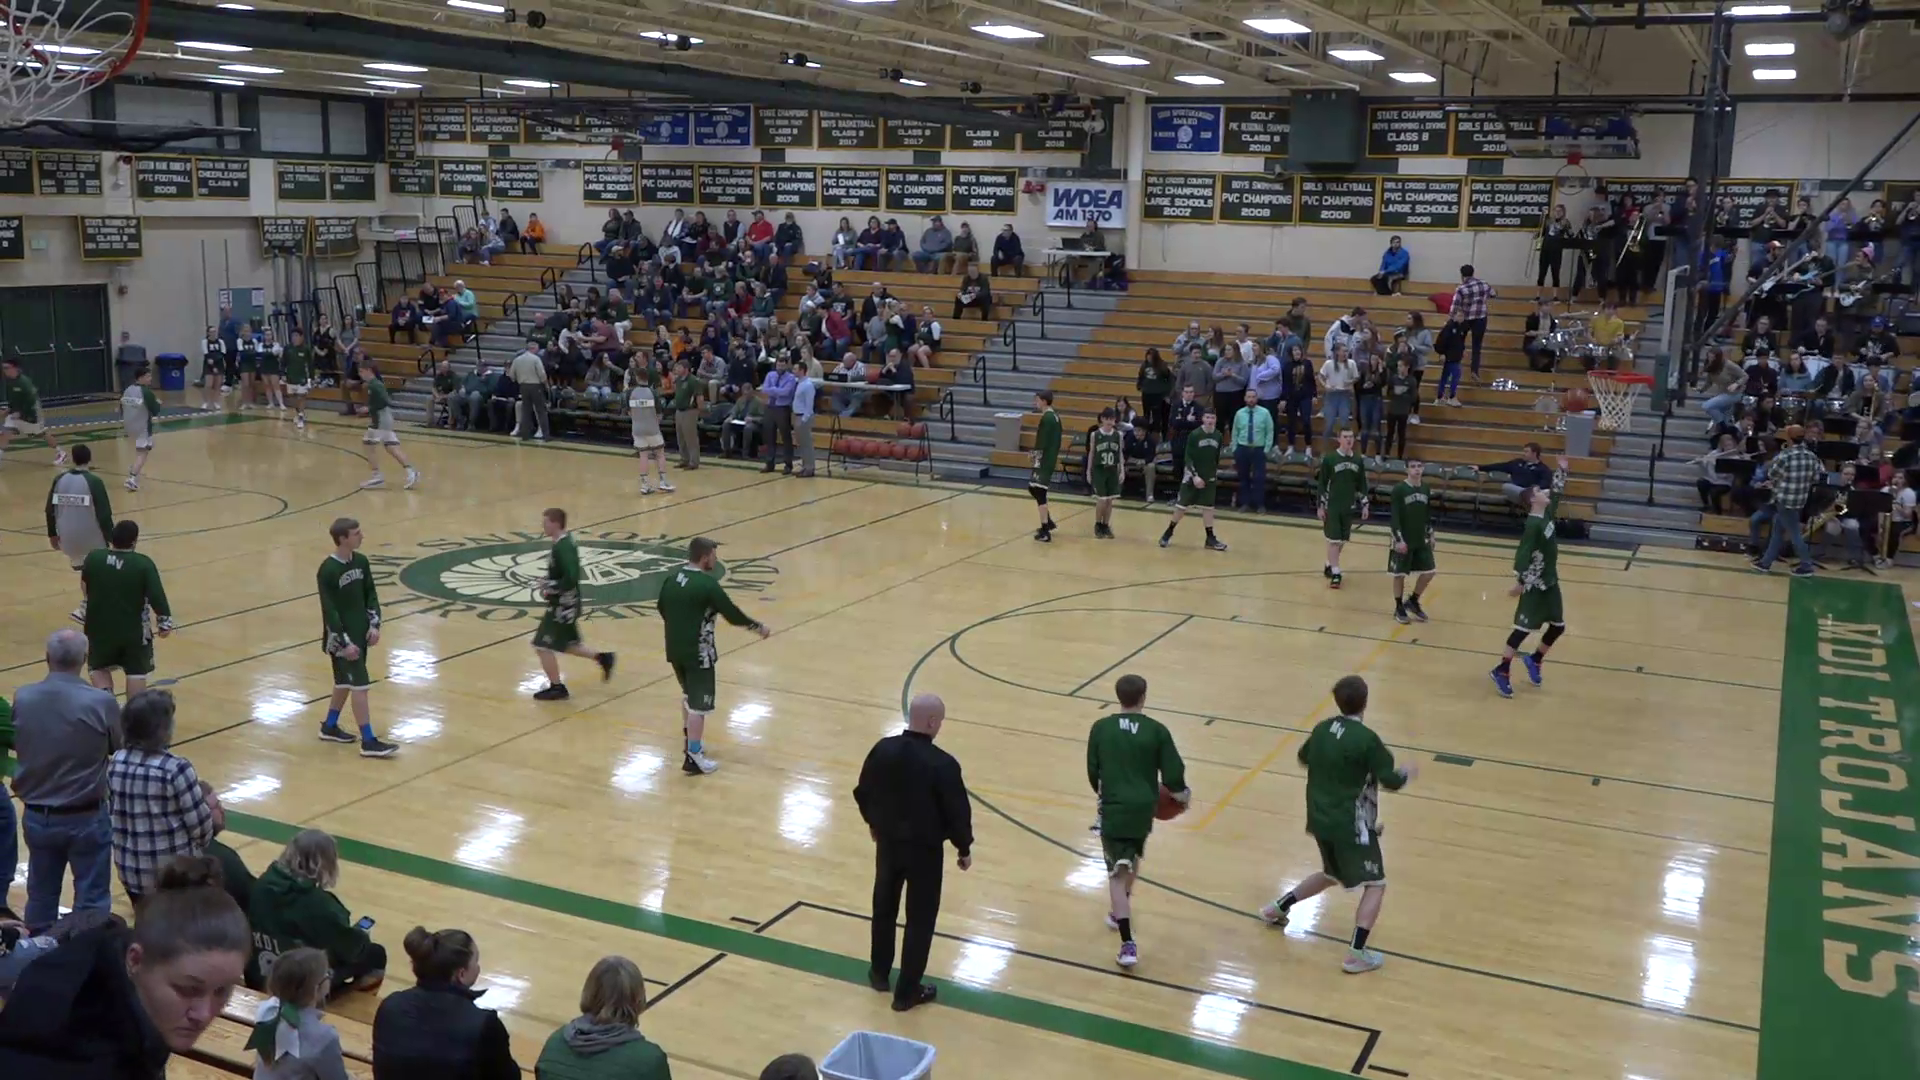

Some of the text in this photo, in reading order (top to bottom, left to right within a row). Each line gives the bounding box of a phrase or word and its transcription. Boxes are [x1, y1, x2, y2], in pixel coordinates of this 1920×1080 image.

[778, 109, 810, 118] CHAMPIONS
[1250, 110, 1276, 120] GOLF
[1377, 110, 1444, 120] STATE CHAMPIONS
[433, 115, 465, 123] CHAMPIONS
[471, 115, 518, 124] PVC CHAMPIONS
[821, 119, 876, 129] BOYS BASKETBALL
[471, 124, 520, 133] LARGE SCHOOLS
[1371, 121, 1447, 130] BOYS SWIMMING DIVING
[1458, 121, 1481, 131] GIRLS
[832, 129, 854, 137] CLASS
[1037, 130, 1063, 138] CLASS
[1241, 133, 1281, 143] CLASS B
[1387, 131, 1430, 141] CLASS B
[839, 138, 858, 146] 2017
[903, 137, 924, 145] 2017
[1176, 142, 1193, 150] GOLF
[197, 170, 248, 179] CHEERLEADING
[491, 171, 539, 180] PVC CHAMPIONS
[642, 167, 656, 177] BOYS
[761, 170, 777, 179] BOYS
[856, 170, 880, 179] COUNTRY
[154, 173, 191, 183] FOOTBALL
[440, 173, 488, 183] PVC CHAMPIONS
[583, 173, 634, 183] PVC CHAMPIONS
[699, 176, 754, 187] PVC CHAMPIONS
[888, 173, 904, 182] BOYS
[959, 174, 1008, 184] BOYS SWIMMING
[1146, 175, 1215, 186] GIRLS CROSS COUNTRY
[208, 179, 231, 187] CLASS
[491, 180, 539, 189] LARGE SCHOOLS
[583, 182, 635, 191] LARGE SCHOOLS
[641, 178, 694, 190] PVC CHAMPIONS
[760, 181, 817, 193] PVC CHAMPIONS
[823, 177, 879, 189] PVC CHAMPIONS
[1231, 180, 1284, 192] BOYS SWIMMING
[1302, 182, 1374, 193] GIRLS VOLLEYBALL
[1382, 180, 1460, 192] GIRLS CROSS COUNTRY
[1471, 182, 1552, 192] GIRLS CROSS COUNTRY
[1606, 183, 1656, 193] GIRLS CROSS
[701, 185, 753, 196] LARGE SCHOOL
[823, 186, 879, 198] LARGE SCHOOL
[887, 184, 946, 196] PVC CHAMPIONS
[952, 185, 1015, 197] PVC CHAMPIONS
[1146, 186, 1214, 198] PVC CHAMPIONS
[1726, 185, 1752, 195] CROSS
[656, 191, 680, 200] 2004
[1053, 187, 1123, 210] WDEA
[1221, 192, 1294, 206] PVC CHAMPIONS
[1383, 191, 1460, 203] PVC CHAMPIONS
[1471, 193, 1550, 205] PVC CHAMPIONS
[969, 198, 996, 208] 2007
[1145, 196, 1214, 209] LARGE SCHOOLS
[1301, 195, 1375, 207] PVC CHAMPIONS
[1163, 207, 1192, 217] 2007
[1381, 203, 1460, 215] LARGE SCHOOLS
[1468, 205, 1550, 216] LARGE SCHOOLS
[1052, 208, 1113, 222] AM 1370
[96, 235, 121, 243] CLASS
[1100, 451, 1115, 466] 30
[106, 554, 125, 571] MV
[1817, 613, 1892, 682] MDI
[1118, 717, 1140, 735] MV
[1818, 695, 1920, 1006] TROJANS
[251, 931, 282, 955] MDI
